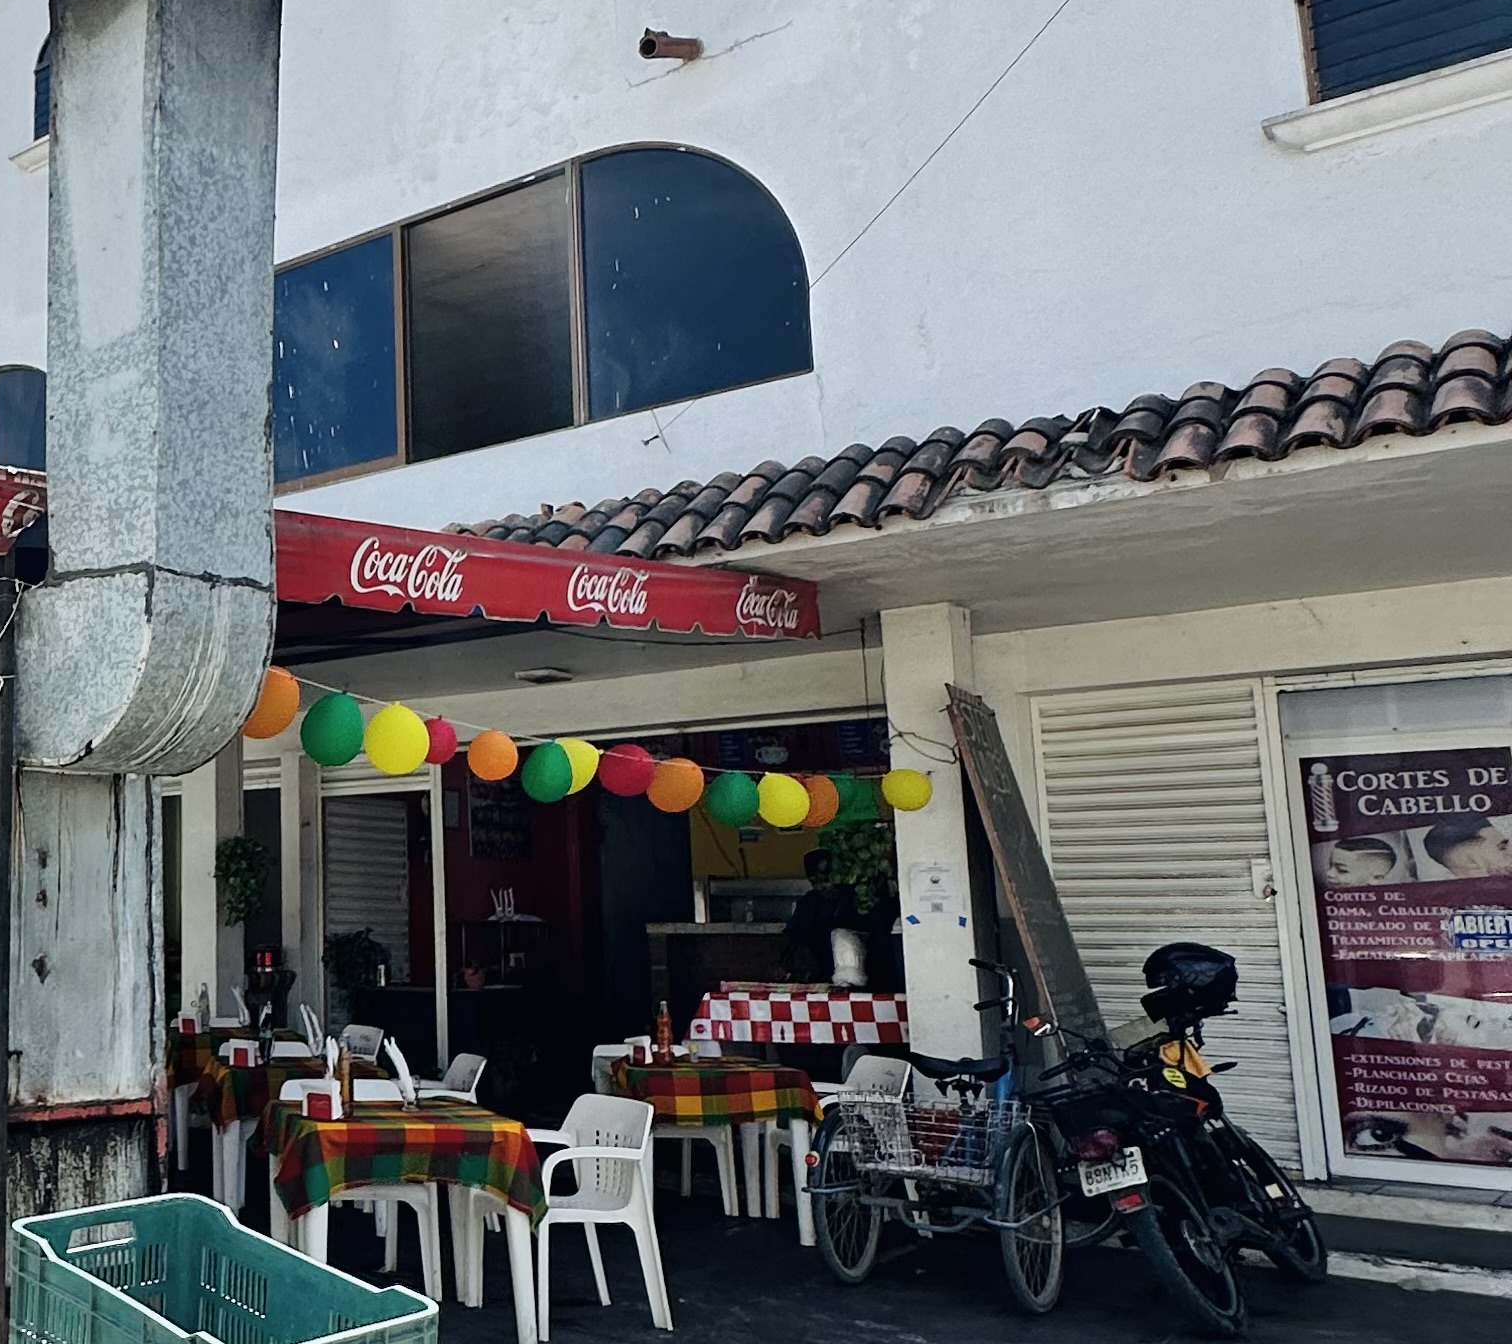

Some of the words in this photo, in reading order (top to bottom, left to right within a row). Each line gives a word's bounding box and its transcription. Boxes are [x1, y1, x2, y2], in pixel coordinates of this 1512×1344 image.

[349, 536, 467, 602] Coca-Cola
[566, 564, 651, 614] Coca-Cola
[735, 579, 799, 629] Coca-Cola
[1337, 769, 1450, 792] CORTES
[1467, 767, 1509, 786] DE
[1357, 793, 1492, 816] CABELLO
[1324, 891, 1377, 902] CORTES
[1328, 919, 1406, 931] DELINEADO
[1413, 920, 1433, 931] DE
[1329, 934, 1435, 946] TRATAMIENTOS
[1460, 937, 1512, 949] OPE
